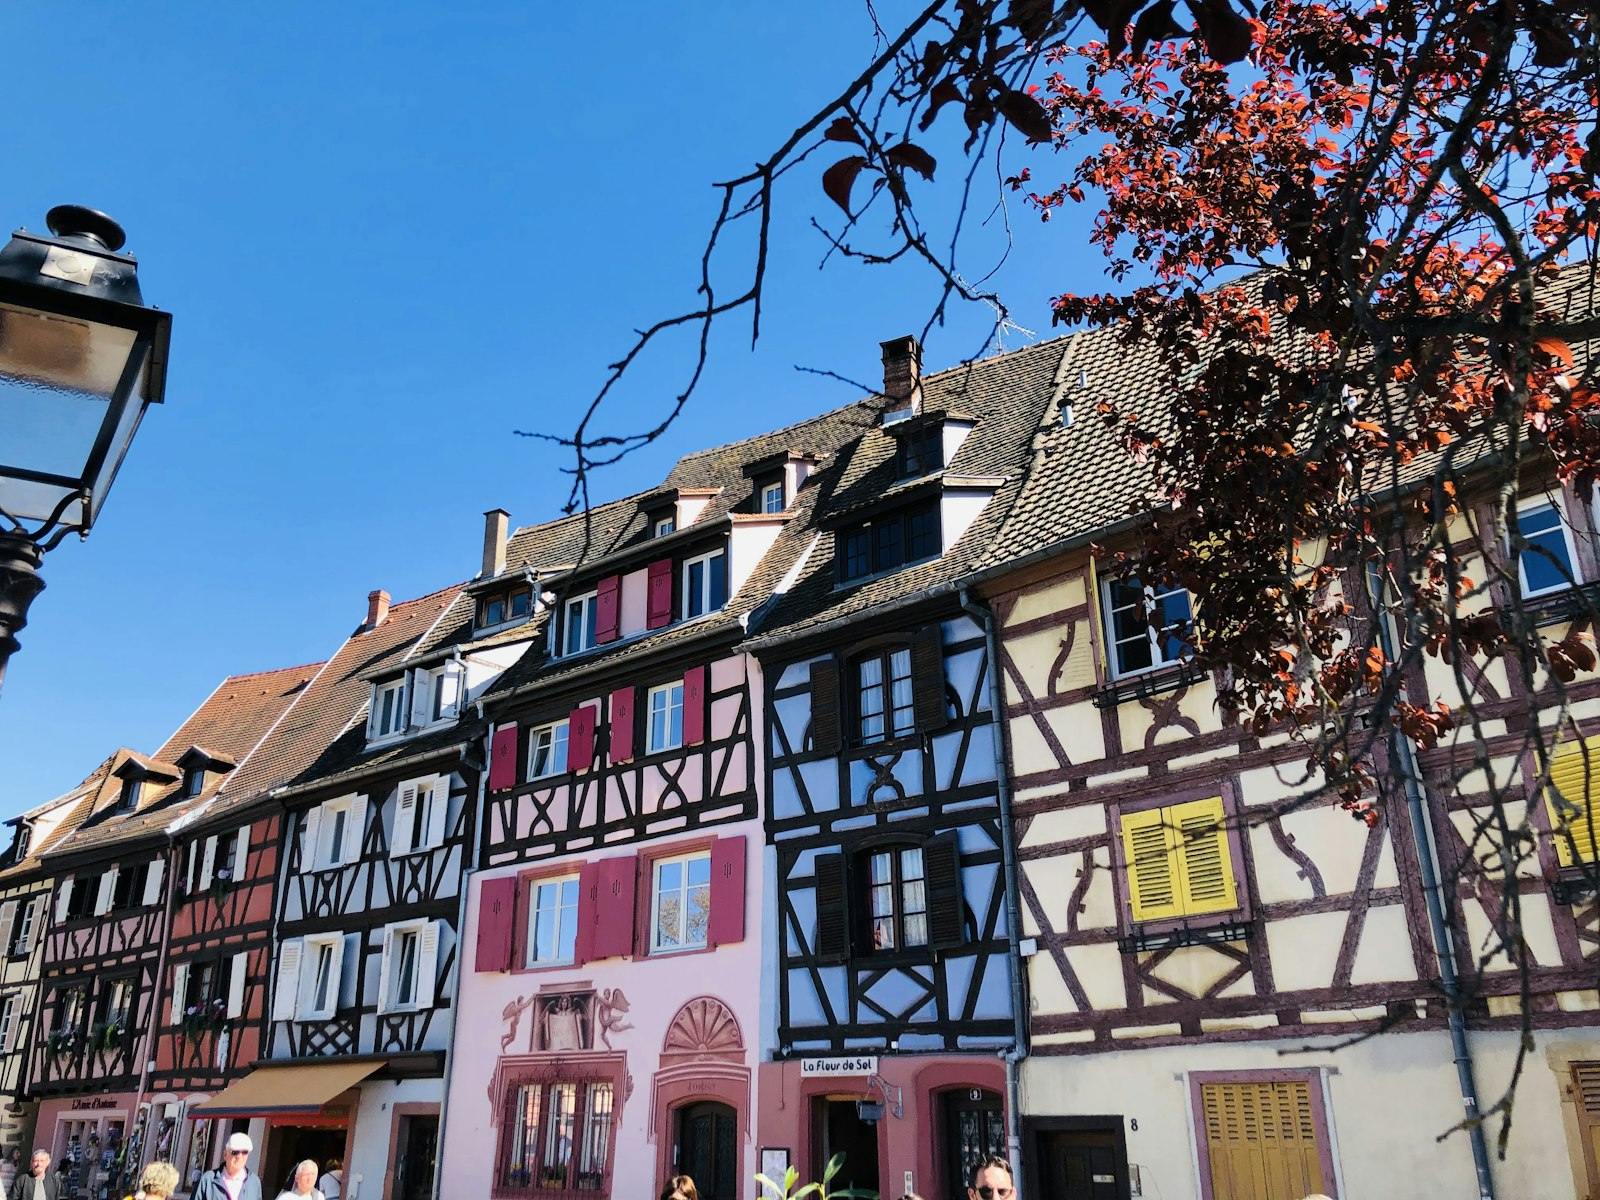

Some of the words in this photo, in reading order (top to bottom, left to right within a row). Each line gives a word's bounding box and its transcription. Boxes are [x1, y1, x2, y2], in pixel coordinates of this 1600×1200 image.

[803, 1061, 814, 1071] La
[816, 1060, 840, 1071] Fleur
[842, 1059, 854, 1070] de
[856, 1059, 871, 1070] Sel
[1131, 1118, 1138, 1131] 8
